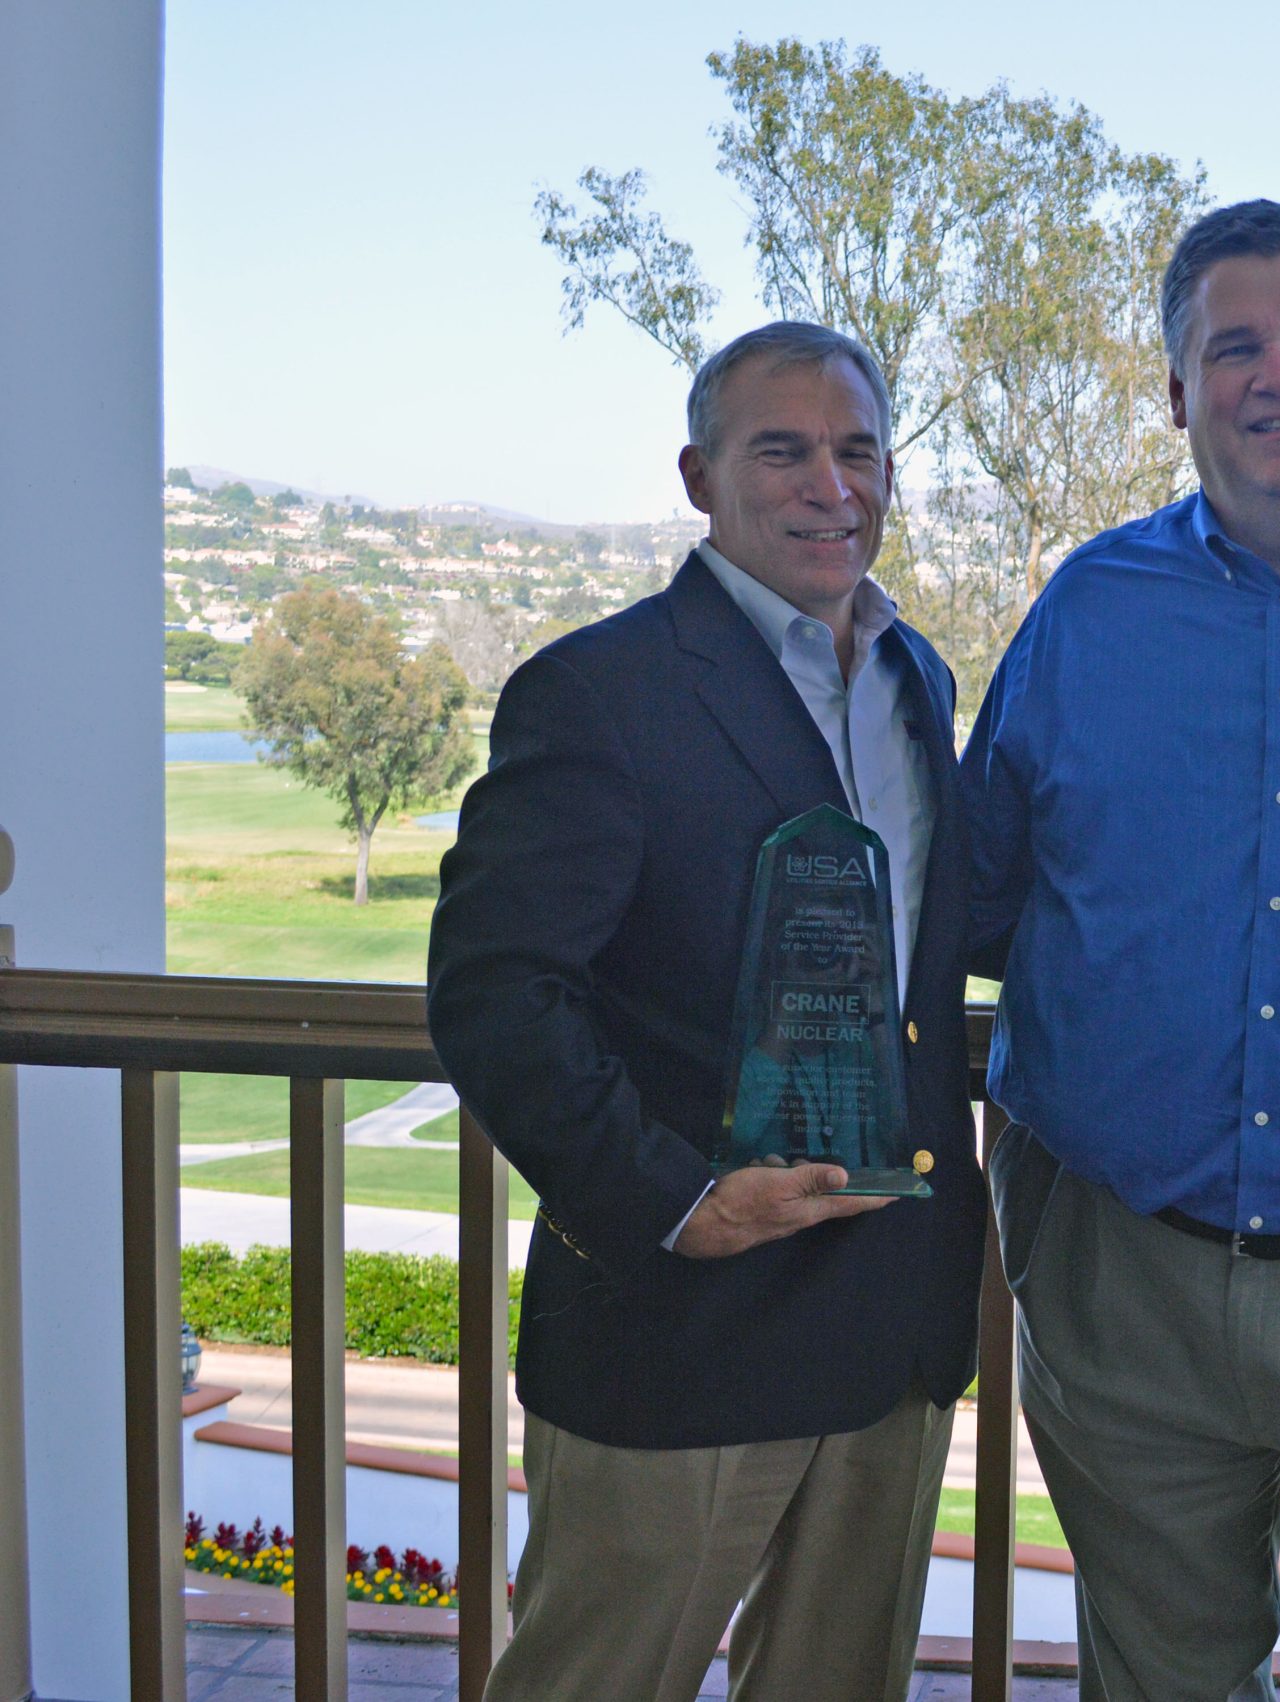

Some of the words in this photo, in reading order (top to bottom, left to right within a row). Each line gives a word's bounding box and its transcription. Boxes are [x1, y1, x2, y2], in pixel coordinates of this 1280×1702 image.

[786, 853, 867, 880] USA
[846, 908, 855, 917] to
[784, 930, 819, 940] Service
[822, 931, 865, 941] Provider
[781, 942, 791, 951] of
[793, 942, 808, 951] the
[811, 943, 832, 952] Year
[834, 944, 865, 953] Award
[781, 992, 860, 1013] CRANE
[776, 1024, 864, 1042] NUCLEAR
